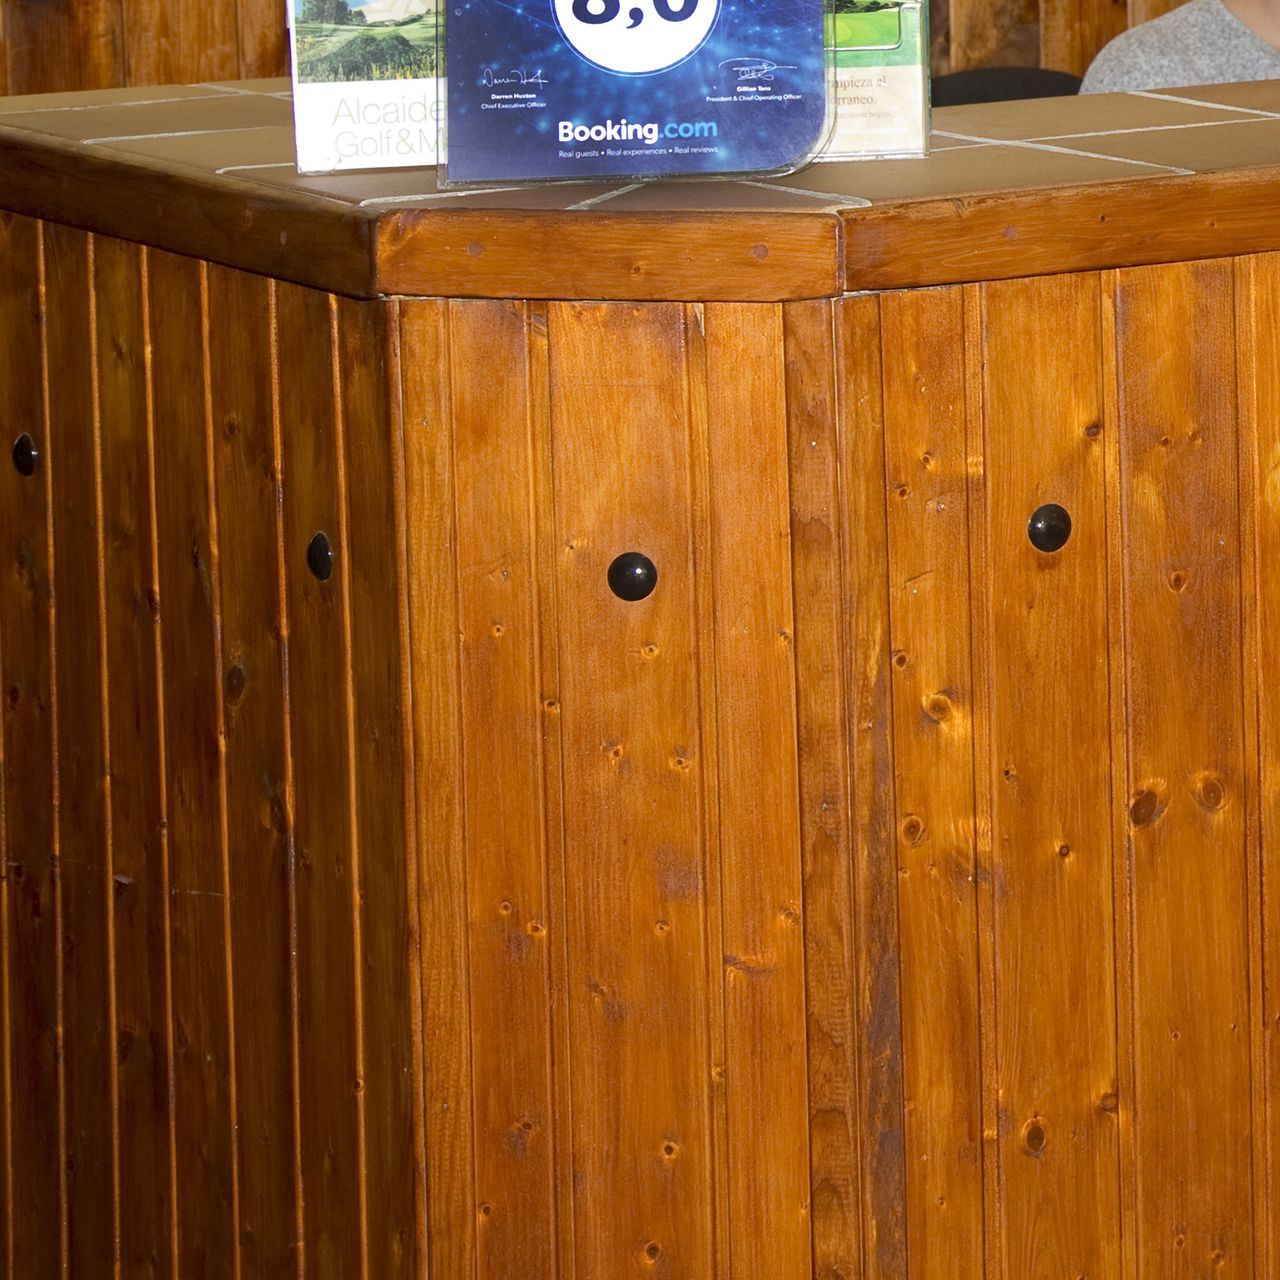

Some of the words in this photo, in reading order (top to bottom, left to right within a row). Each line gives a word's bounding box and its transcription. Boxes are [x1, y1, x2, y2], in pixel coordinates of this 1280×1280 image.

[513, 92, 537, 100] Huston
[526, 101, 547, 109] Officer
[558, 118, 718, 145] Booking.com
[558, 149, 574, 158] Real
[575, 149, 600, 159] guests
[606, 148, 622, 157] Real
[622, 147, 668, 157] experiences
[674, 146, 690, 154] Real
[690, 146, 719, 154] reviews
